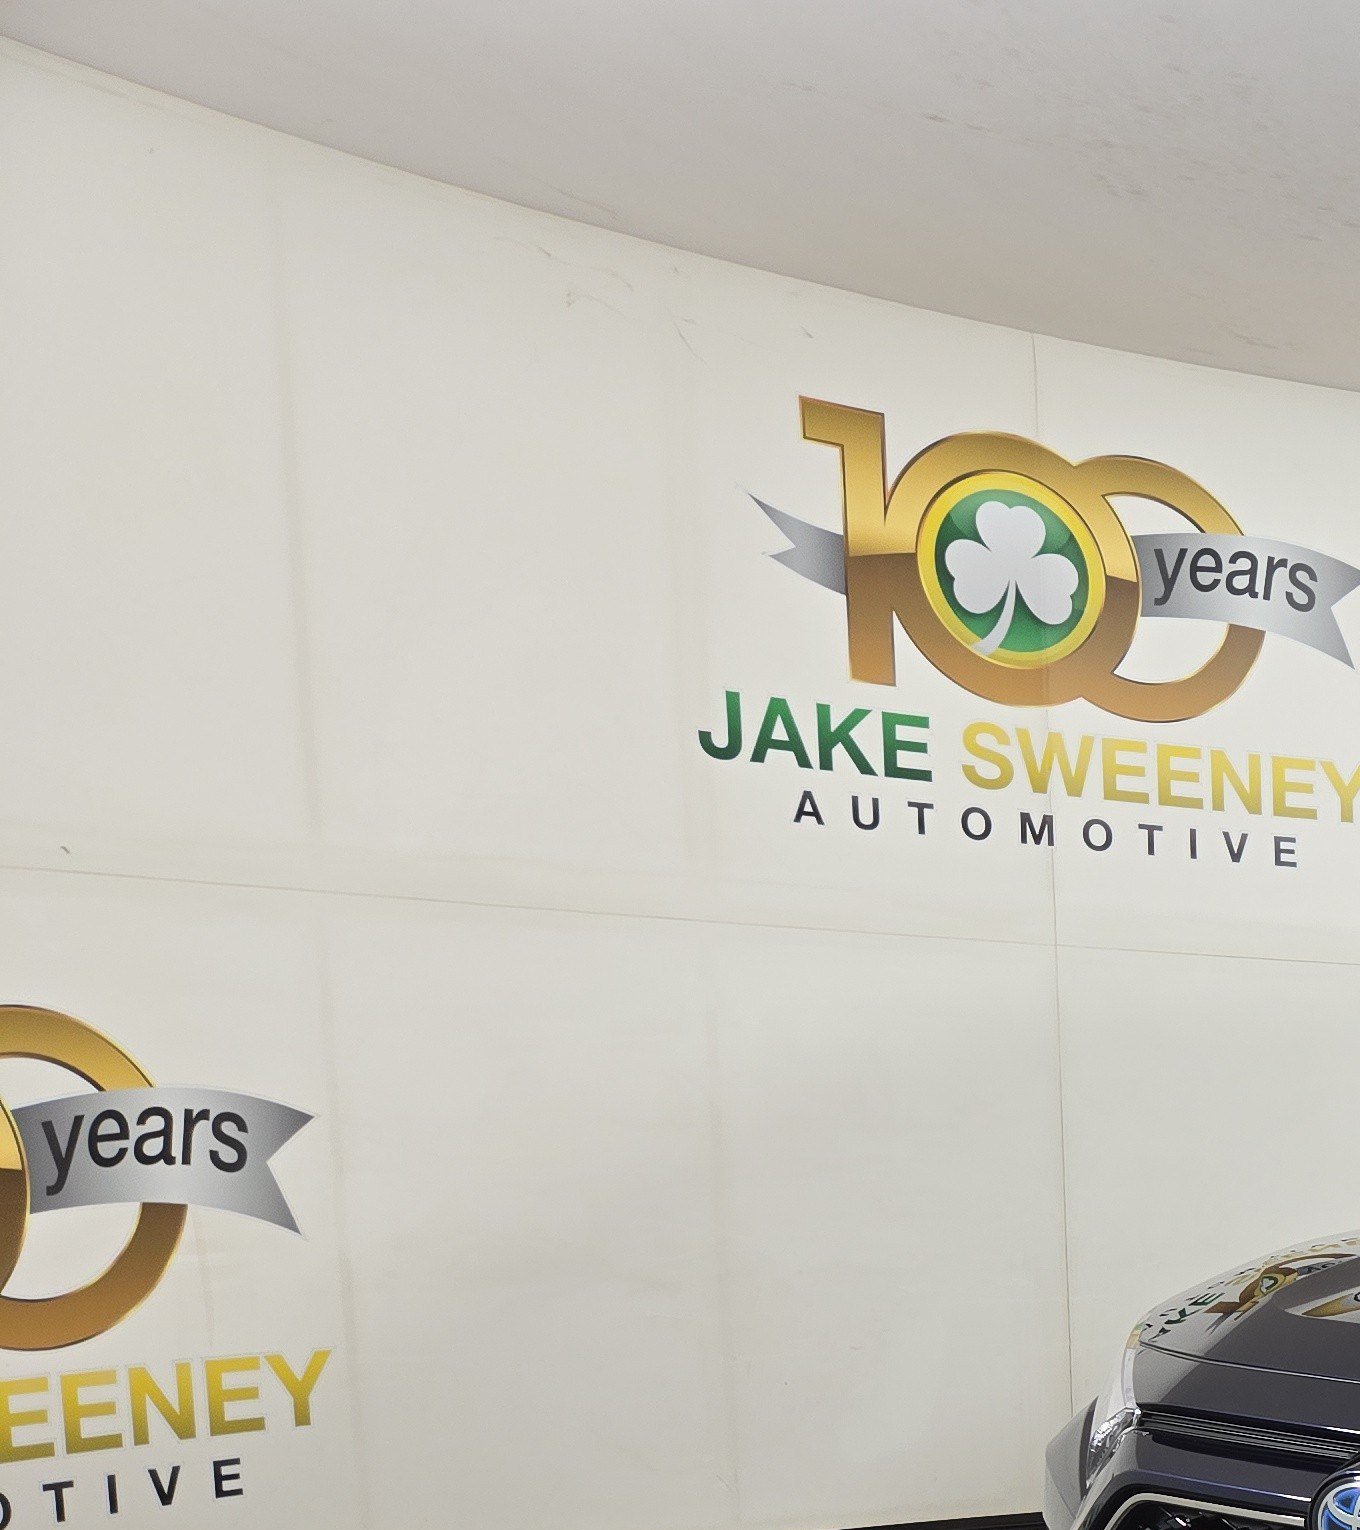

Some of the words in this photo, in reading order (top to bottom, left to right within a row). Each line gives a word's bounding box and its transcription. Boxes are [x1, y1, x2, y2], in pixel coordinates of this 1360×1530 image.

[798, 394, 1267, 724] 100
[1154, 547, 1319, 612] years
[698, 690, 933, 782] JAKE
[793, 789, 1298, 868] AUTOMOTIVE
[41, 1105, 249, 1197] years
[0, 1349, 332, 1465] EENEY
